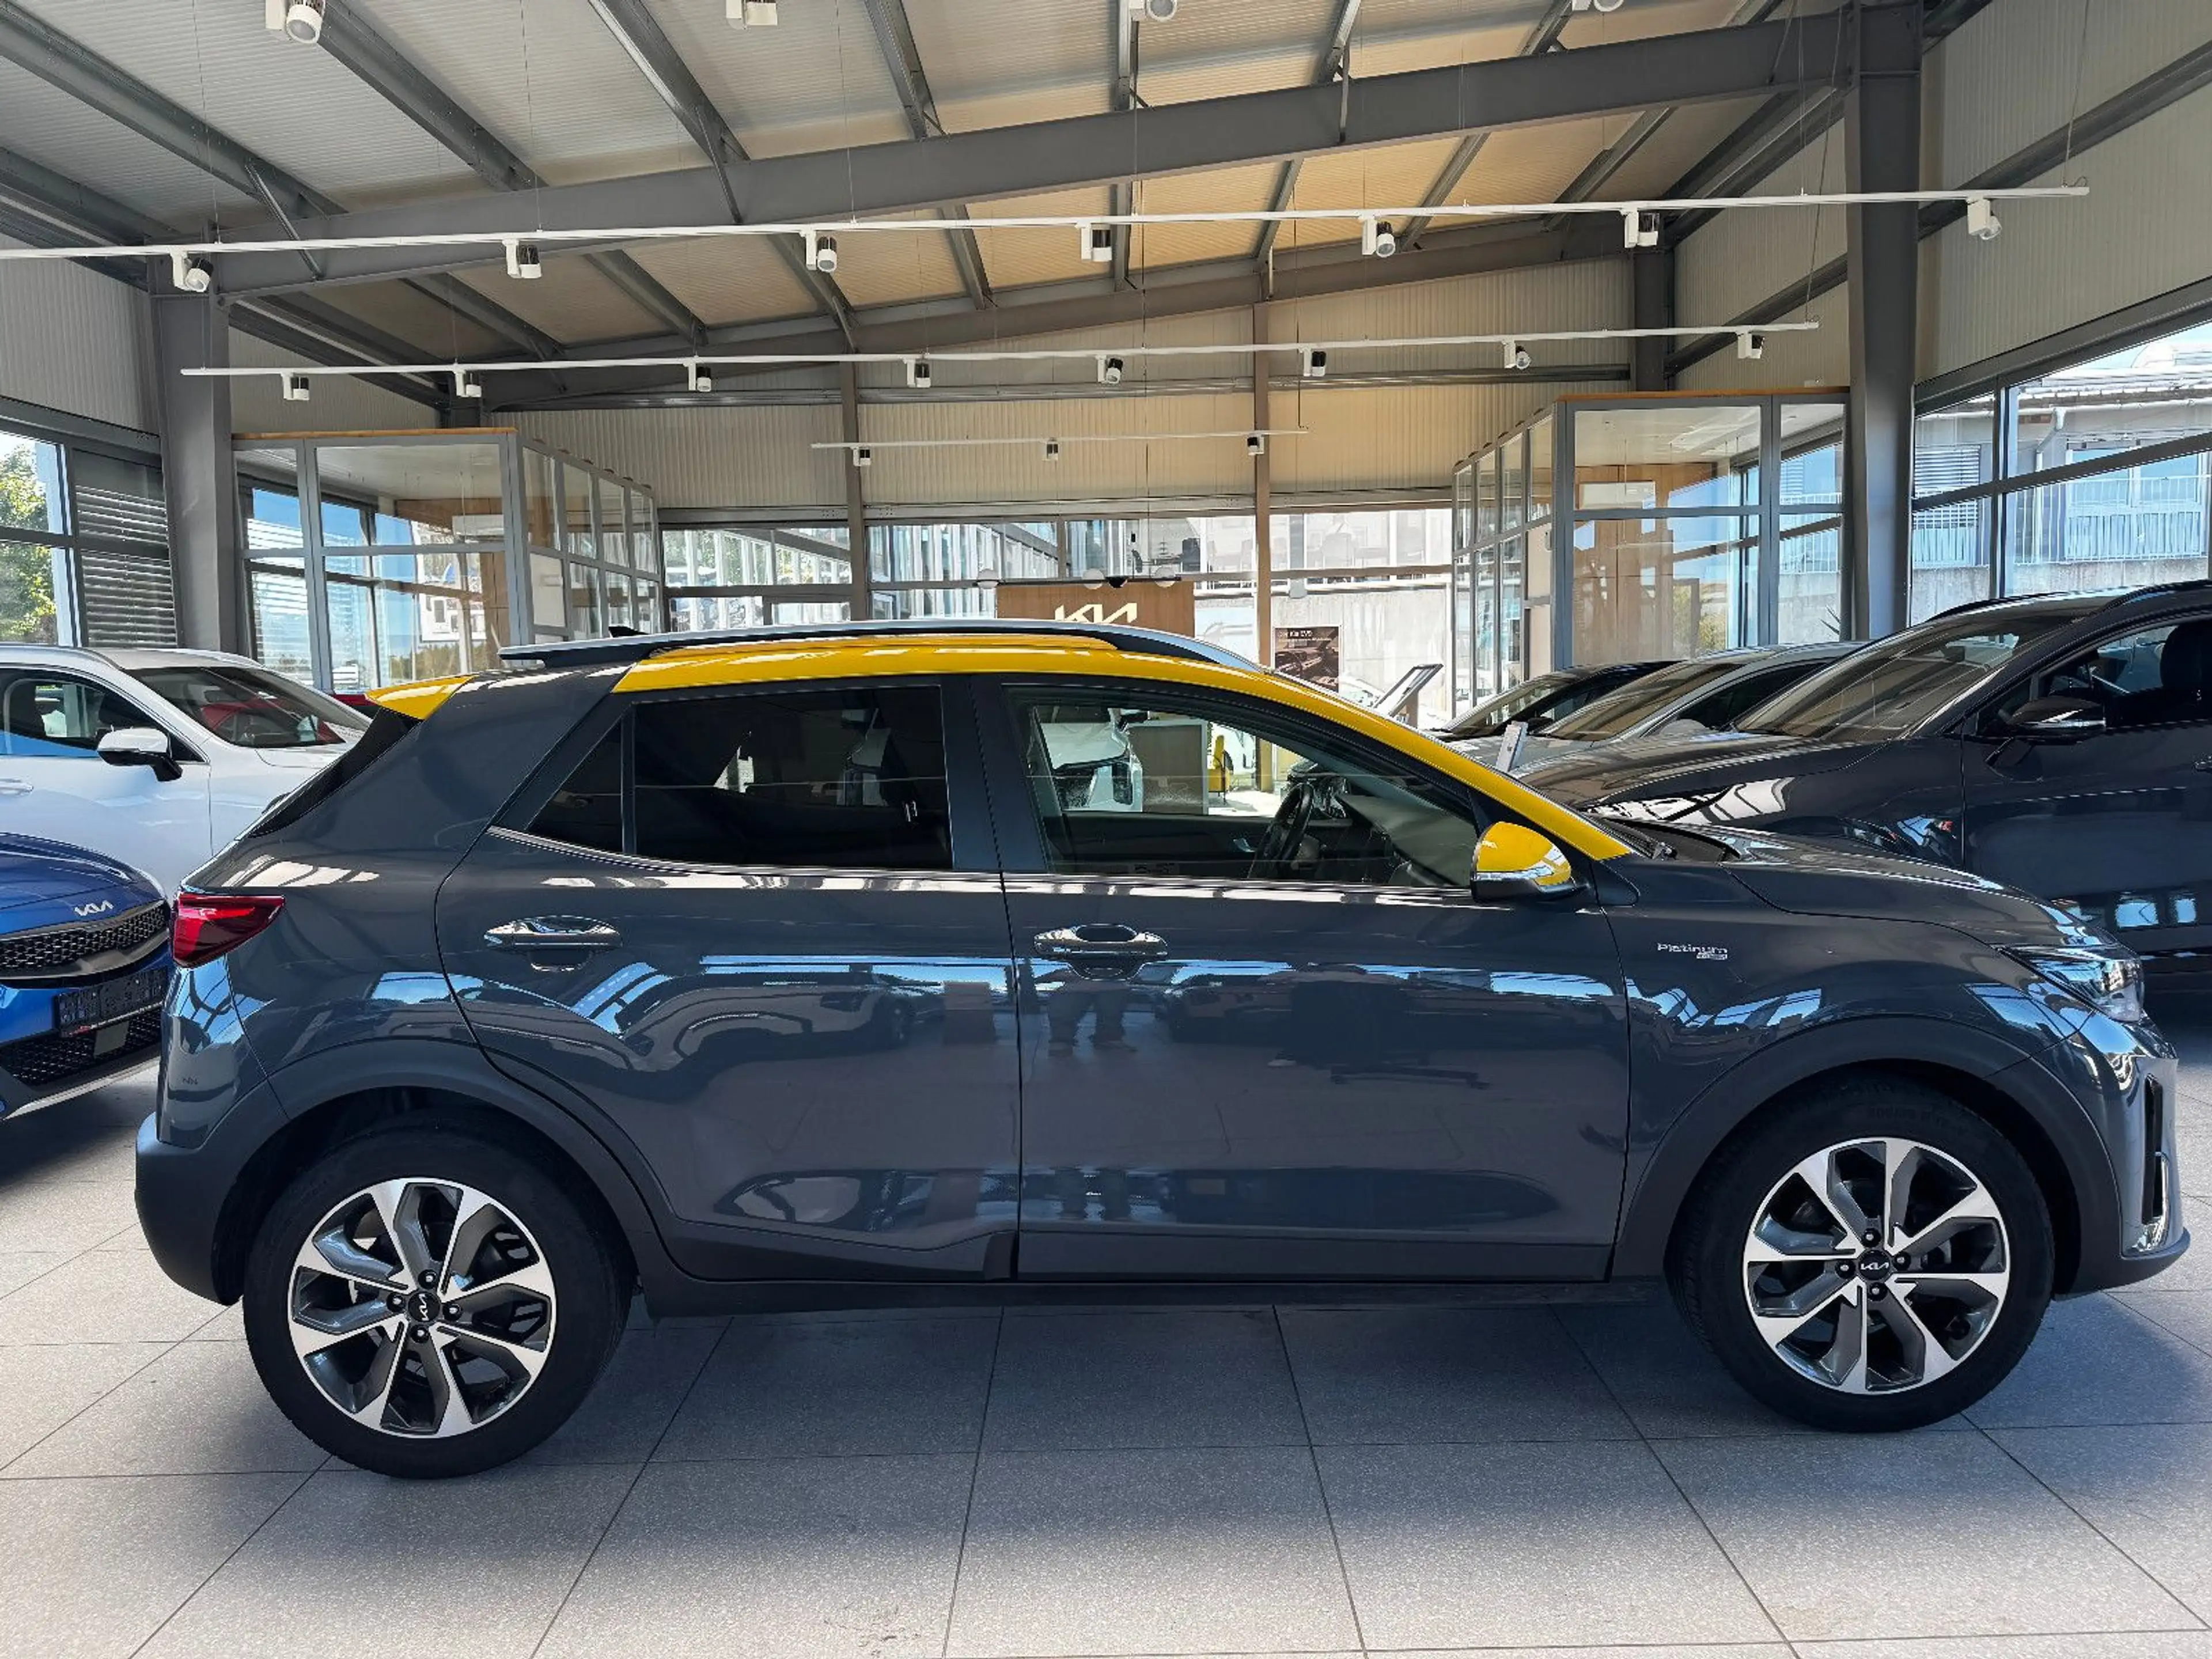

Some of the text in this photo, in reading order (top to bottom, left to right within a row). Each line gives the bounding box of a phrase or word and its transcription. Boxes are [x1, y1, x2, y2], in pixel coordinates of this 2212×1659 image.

[1055, 603, 1138, 623] KIA
[74, 900, 114, 916] KIA
[1861, 1262, 1889, 1270] KIA
[418, 1293, 429, 1321] KIA
